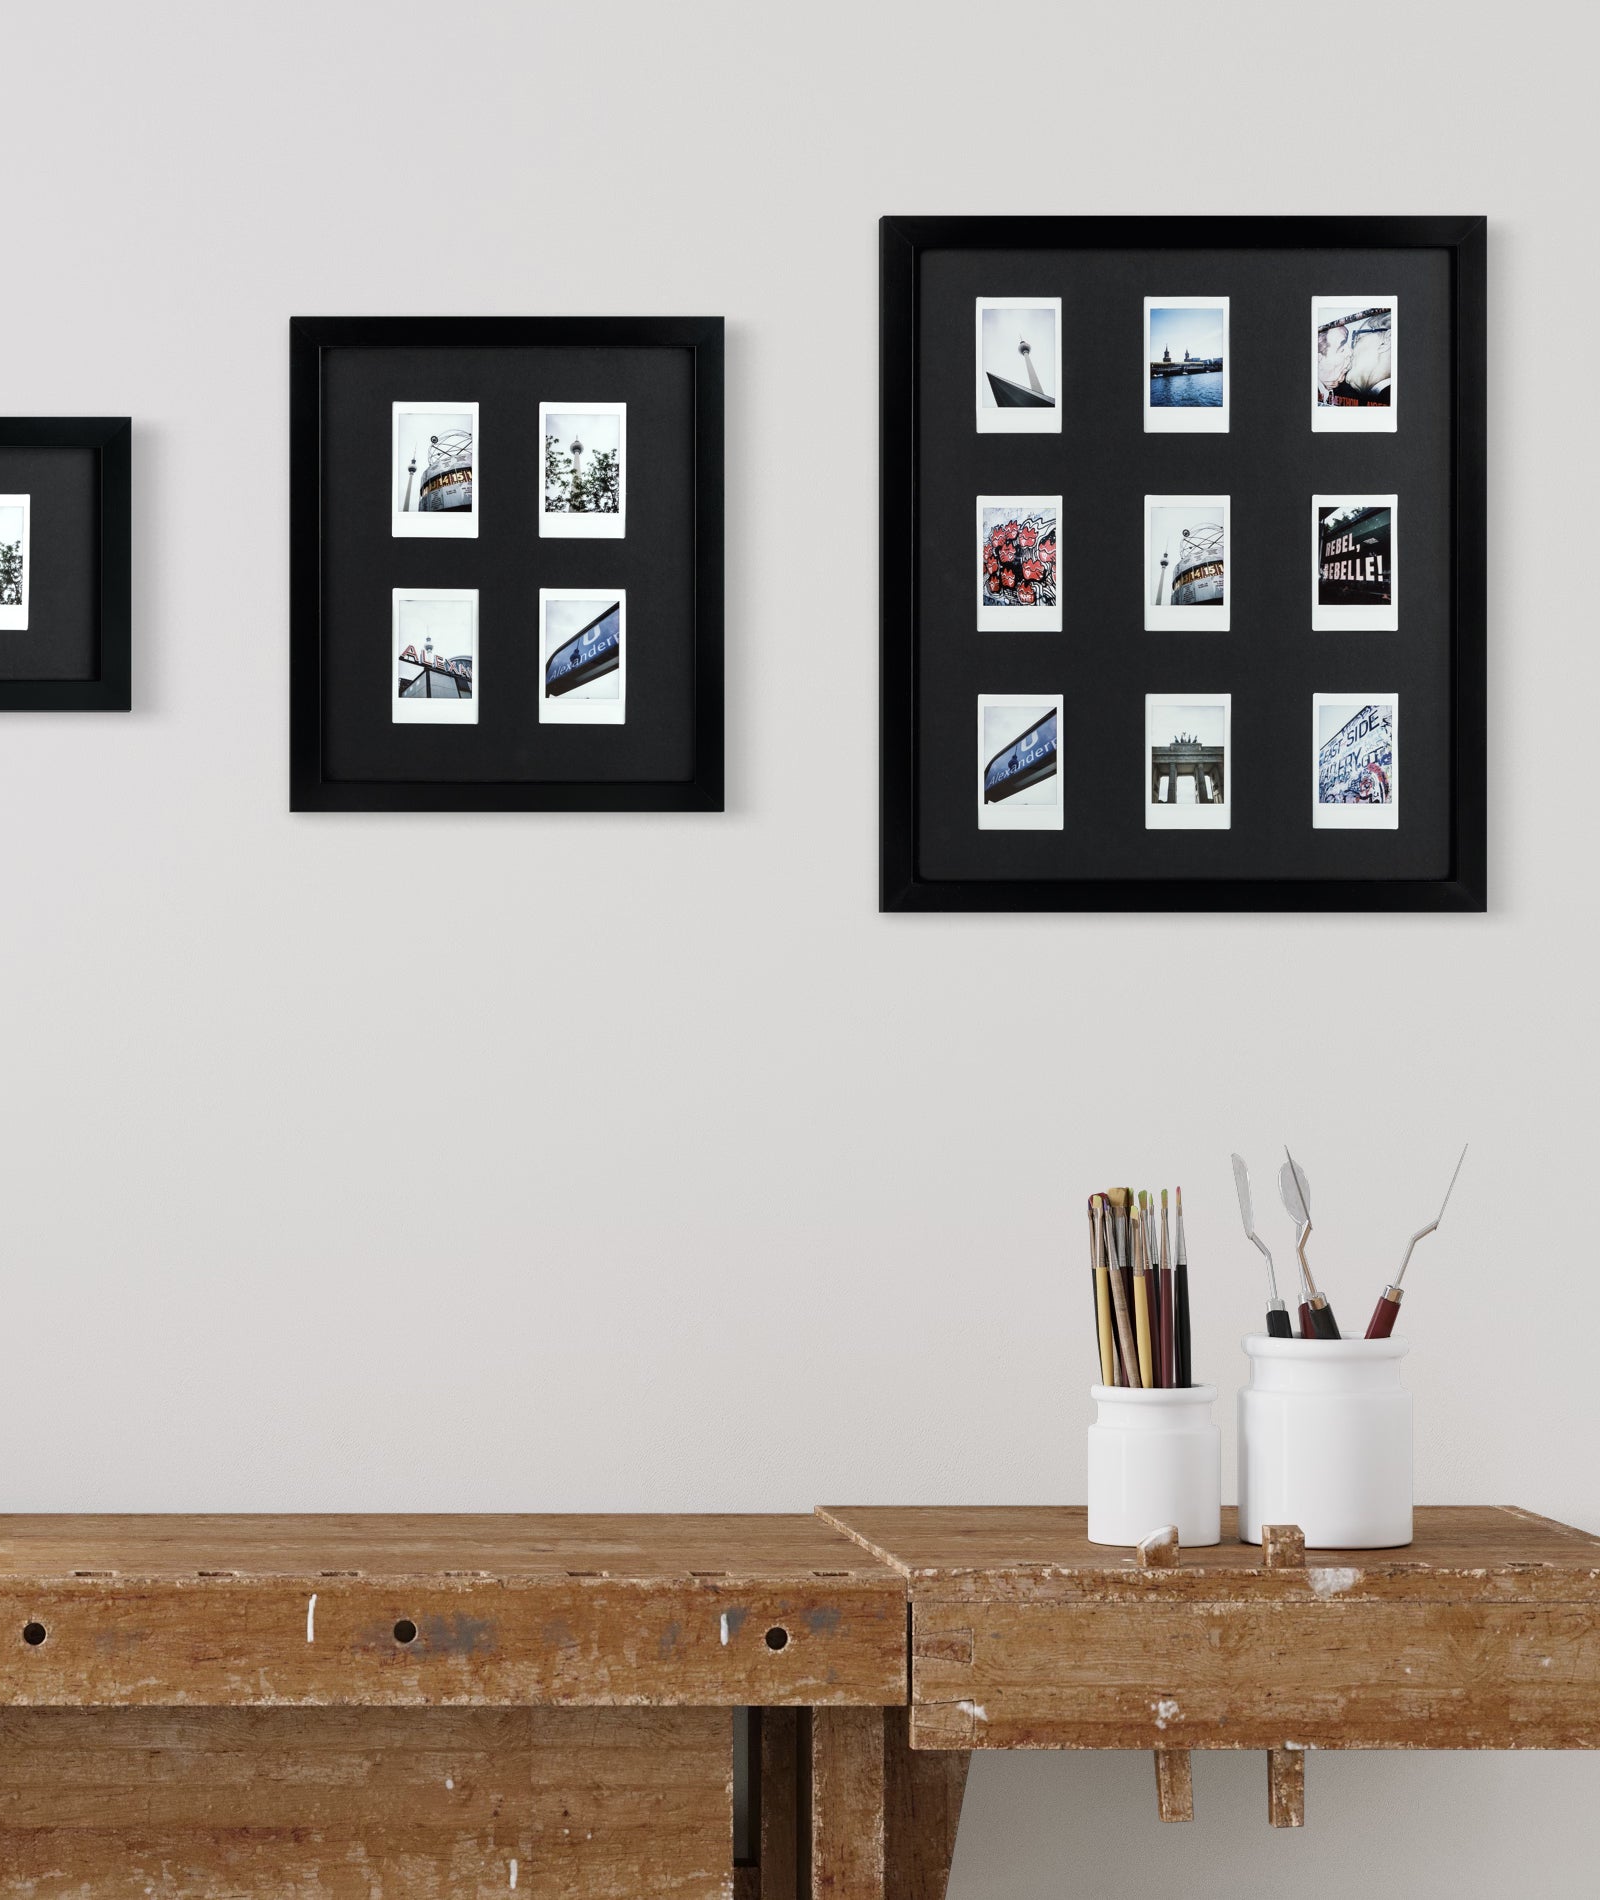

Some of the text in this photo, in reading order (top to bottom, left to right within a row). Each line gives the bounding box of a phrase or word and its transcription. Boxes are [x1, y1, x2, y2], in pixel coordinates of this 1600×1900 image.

[452, 472, 464, 482] 15
[1325, 532, 1361, 557] REBEL,
[1204, 565, 1216, 575] 15
[1322, 554, 1384, 582] REBELLE!
[1346, 709, 1380, 747] SIDE
